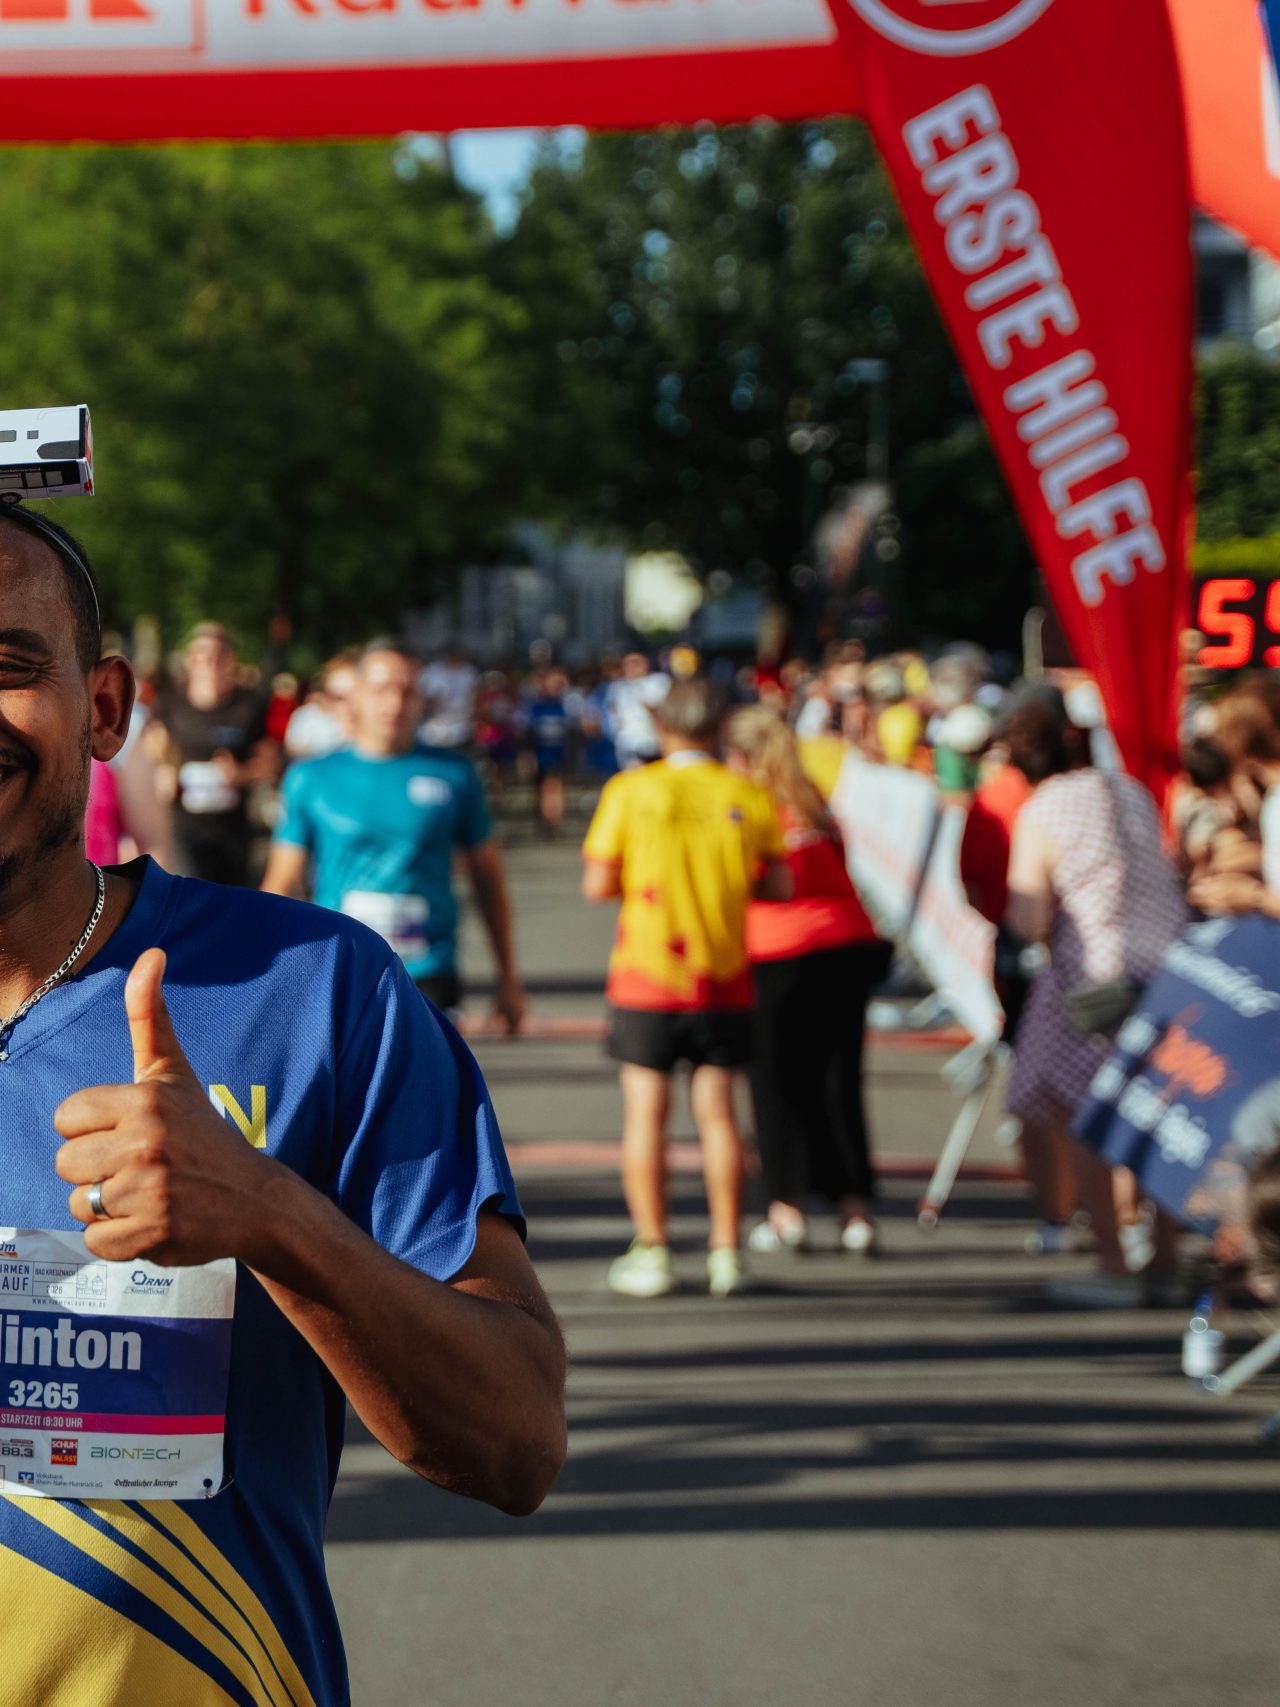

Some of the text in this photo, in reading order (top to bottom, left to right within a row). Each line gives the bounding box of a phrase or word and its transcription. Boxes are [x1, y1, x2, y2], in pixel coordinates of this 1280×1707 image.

[902, 83, 1167, 607] ERSTE HILFE
[1197, 579, 1280, 668] 5
[8, 1379, 79, 1410] 3265
[1, 1413, 83, 1429] STARTZEIT 18:30 UHR
[1, 1446, 33, 1457] 88.3
[51, 1440, 78, 1449] SCHUH
[51, 1454, 77, 1463] PALAST
[90, 1446, 180, 1460] BIONTECH
